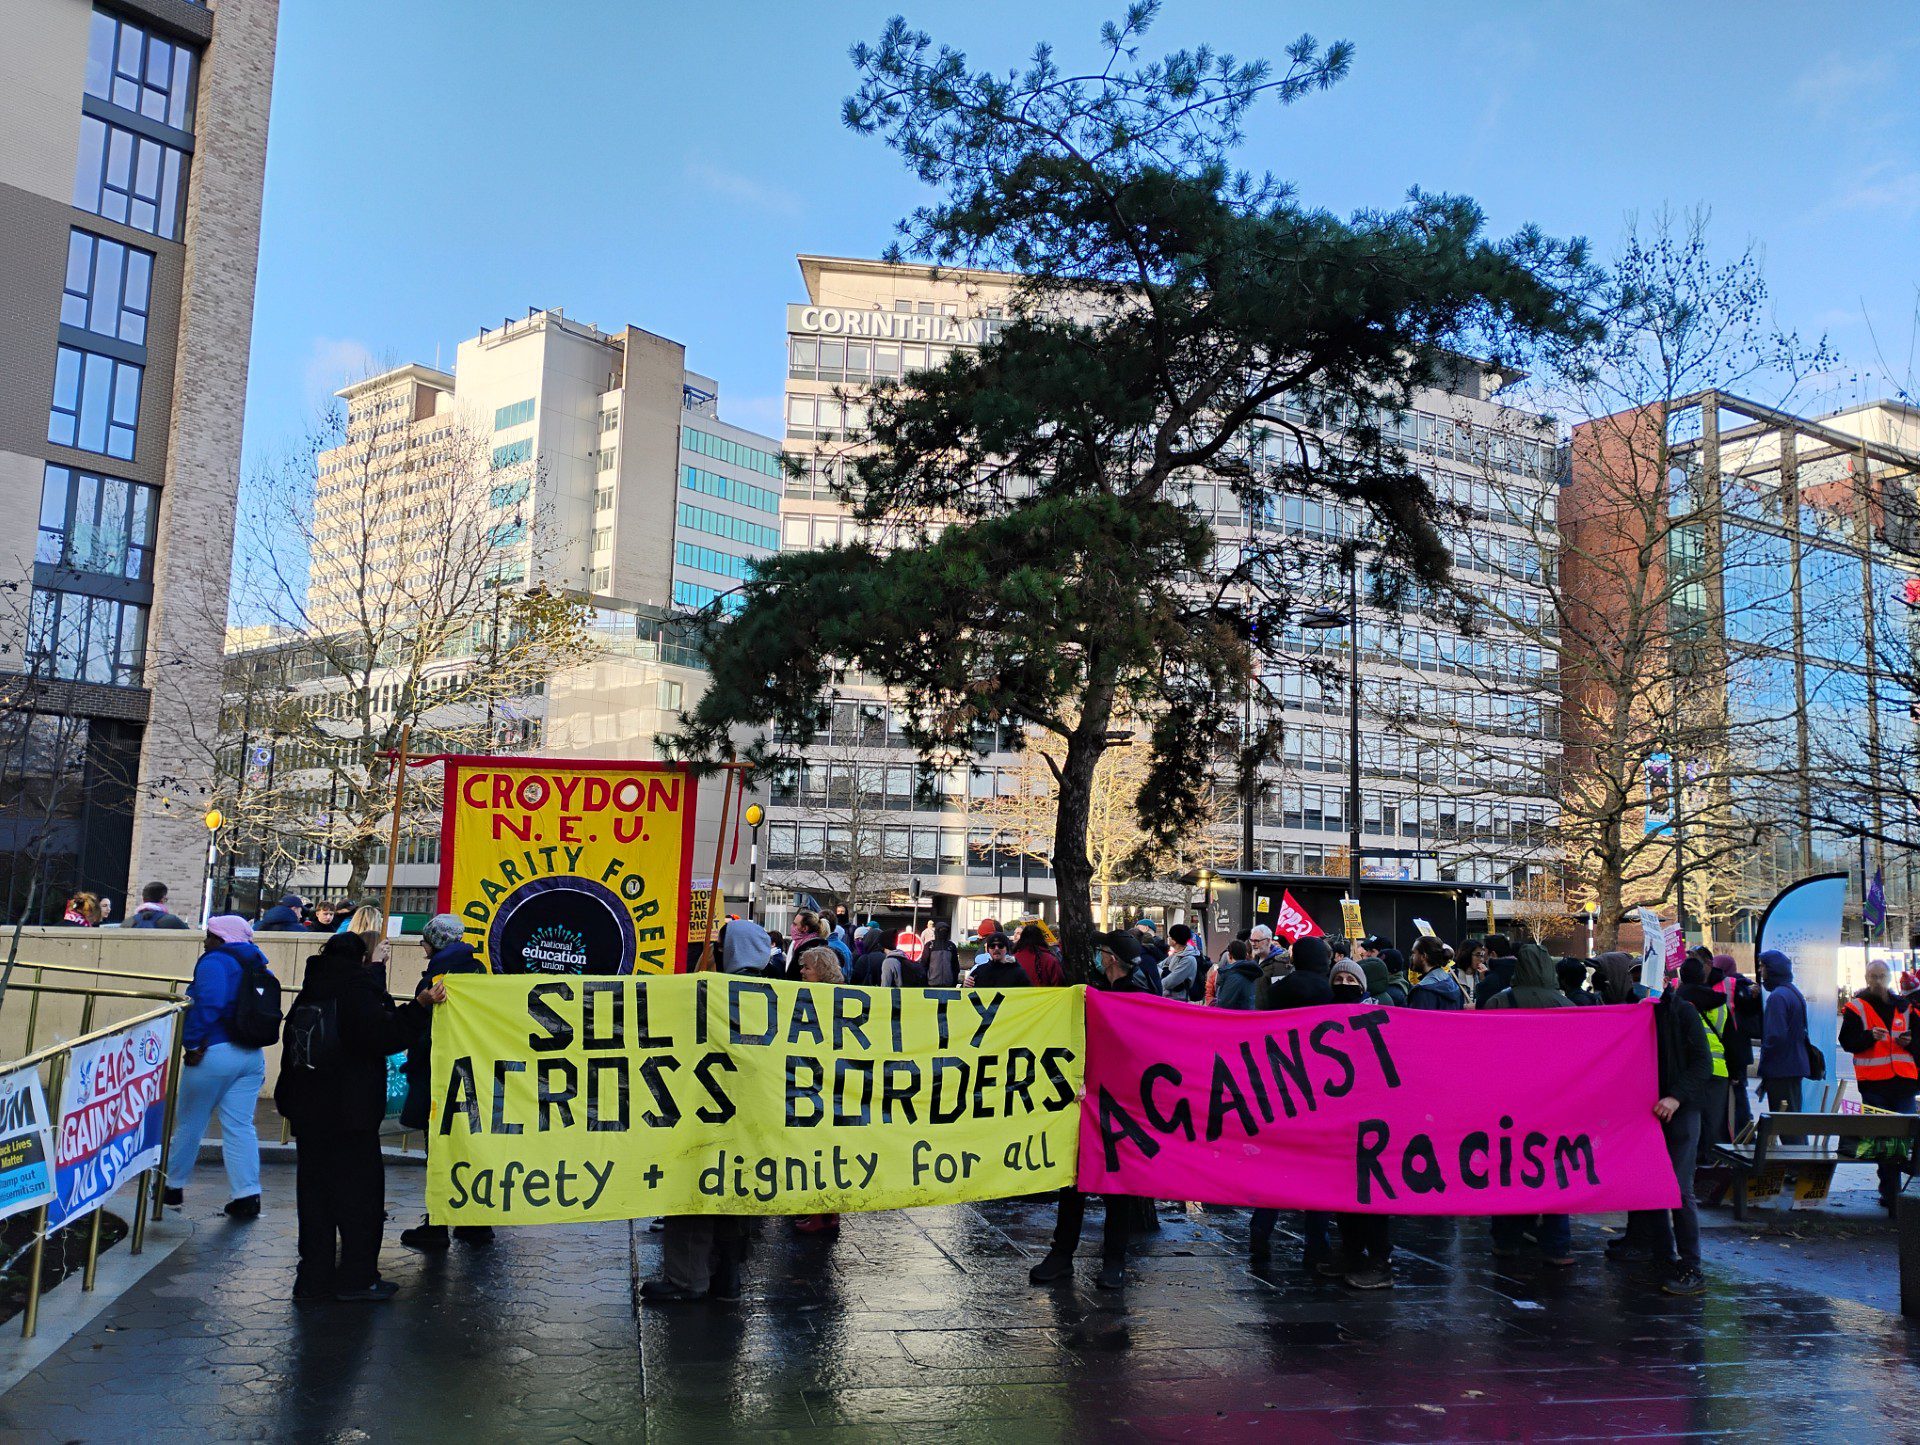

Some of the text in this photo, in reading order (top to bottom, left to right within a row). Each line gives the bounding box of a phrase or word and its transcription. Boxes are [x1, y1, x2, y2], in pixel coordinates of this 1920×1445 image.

[801, 307, 984, 344] CORINTHIAN
[463, 773, 681, 812] CROYDON
[463, 846, 667, 975] LIDARITY FOREV
[690, 920, 719, 930] RIGT
[522, 946, 587, 965] education
[540, 940, 573, 951] national
[541, 961, 565, 971] union
[527, 979, 1006, 1052] SOLIDARITY
[439, 1047, 1076, 1136] ACROSS BORDERS
[1099, 1009, 1401, 1173] AGAINST
[1, 1154, 24, 1168] Matter
[12, 1139, 32, 1152] Lives
[1356, 1115, 1601, 1205] Racism
[20, 1169, 36, 1180] out
[448, 1160, 615, 1212] Safety
[698, 1145, 878, 1202] dignity
[912, 1140, 981, 1186] for
[1003, 1131, 1056, 1171] all
